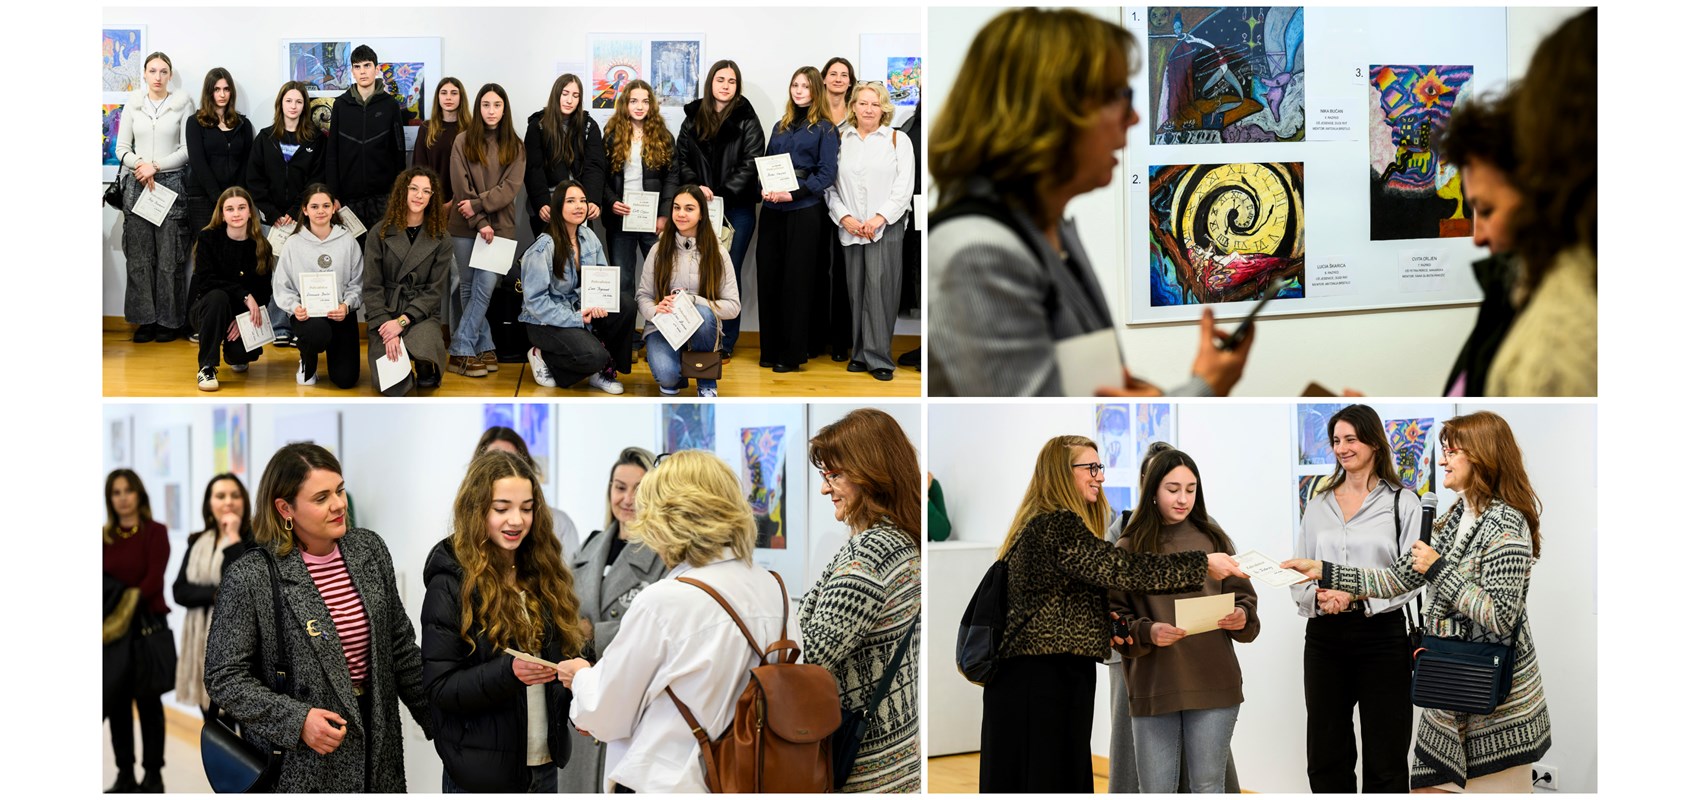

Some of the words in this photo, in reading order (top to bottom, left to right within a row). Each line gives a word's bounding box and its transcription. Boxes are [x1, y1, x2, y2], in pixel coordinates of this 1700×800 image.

[1132, 11, 1140, 21] 1.
[1356, 68, 1364, 78] 3.
[1132, 174, 1141, 184] 2.
